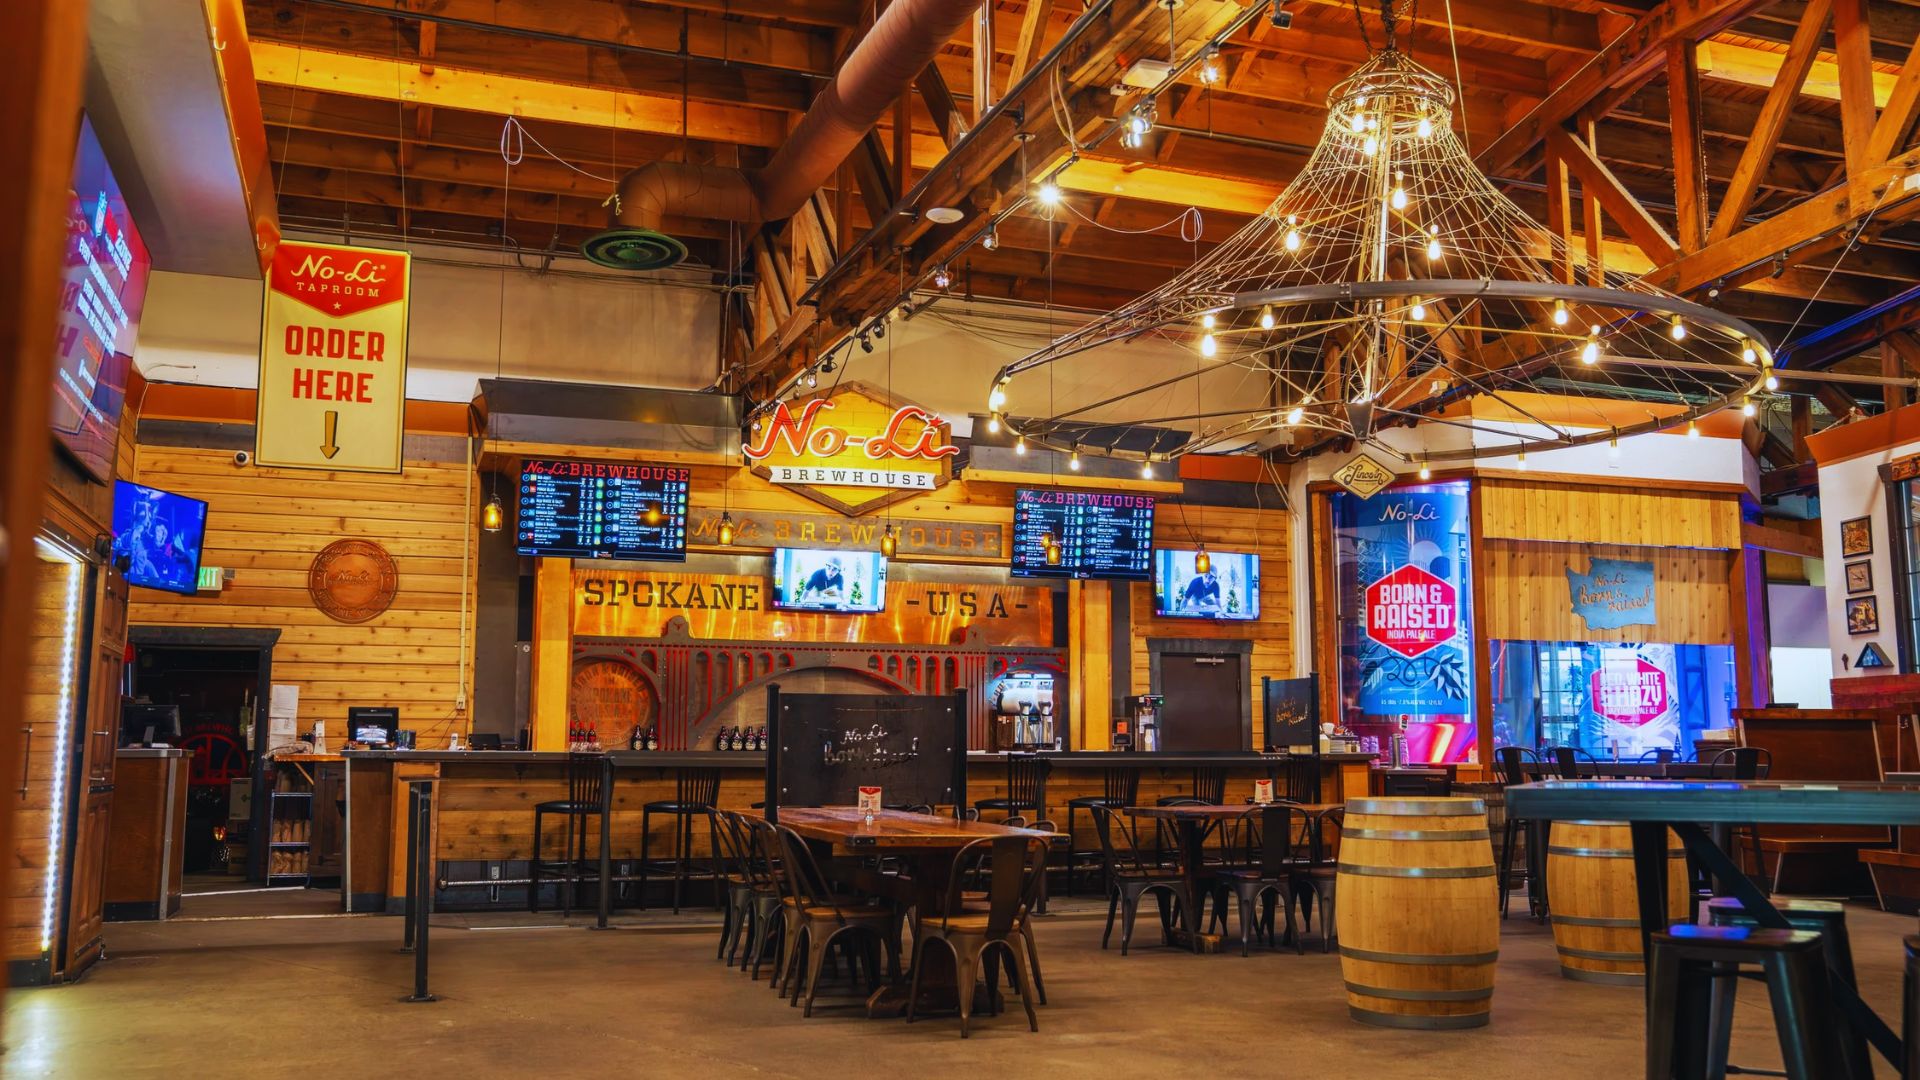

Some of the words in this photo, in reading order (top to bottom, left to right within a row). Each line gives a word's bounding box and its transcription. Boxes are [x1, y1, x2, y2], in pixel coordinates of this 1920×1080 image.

[290, 254, 386, 284] No-Li
[296, 282, 380, 298] TAPROOM
[285, 325, 385, 362] ORDER
[292, 368, 374, 404] HERE
[741, 398, 960, 460] No-Li
[523, 461, 568, 475] No-Li
[569, 463, 689, 481] BREWHOUSE
[782, 468, 926, 486] BREWHOUSE
[1017, 491, 1054, 503] No-Li
[1055, 492, 1154, 509] BREWHOUSE
[1378, 503, 1440, 521] No-Li
[198, 567, 219, 588] XIT
[584, 579, 759, 611] SPOKANE
[1380, 584, 1427, 605] BORN
[1430, 584, 1442, 604] &
[1374, 604, 1450, 630] RAISED
[1387, 630, 1405, 640] INDIA
[1406, 630, 1422, 640] PALE
[1423, 630, 1436, 640] ALE
